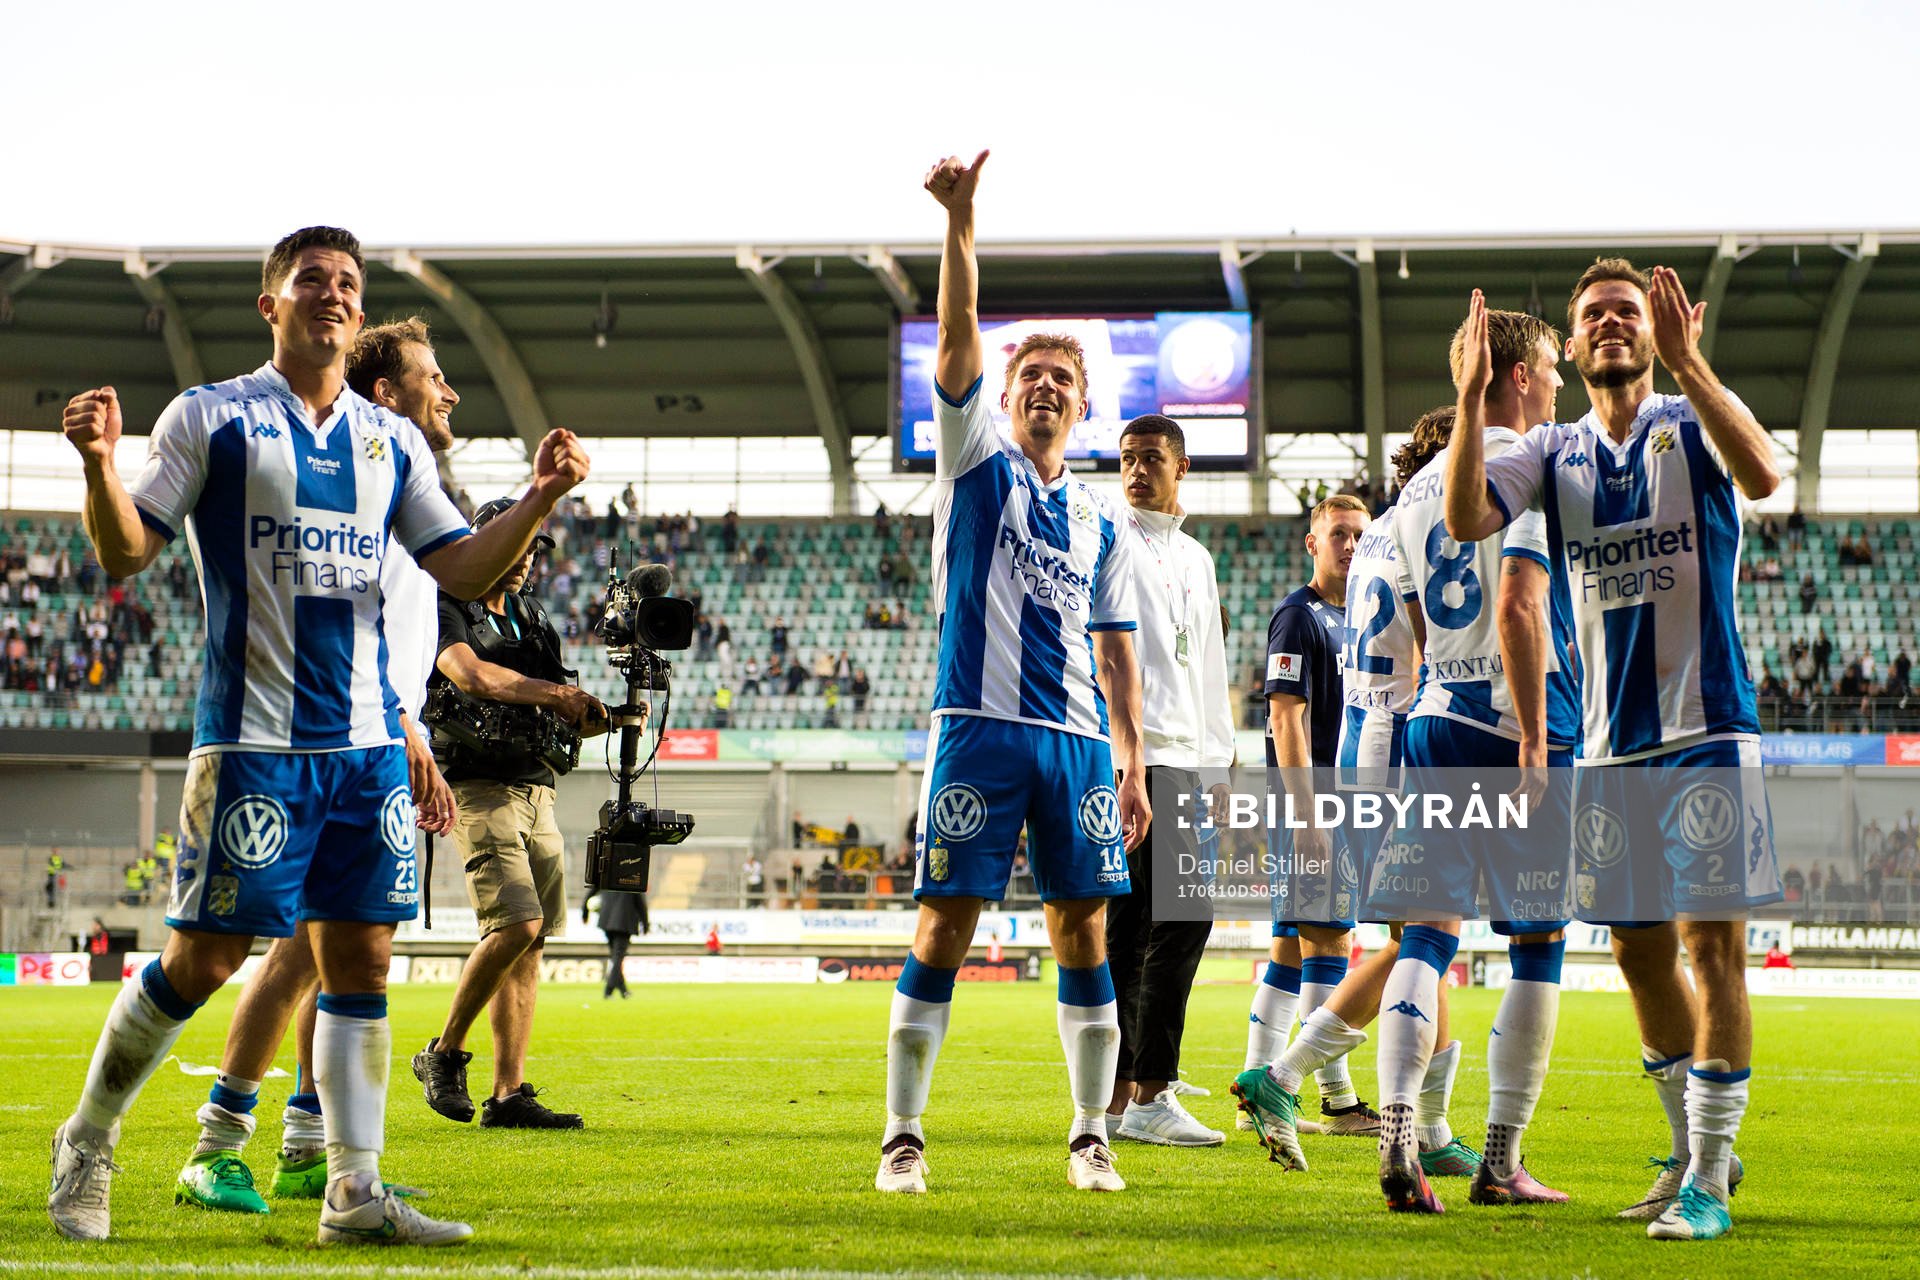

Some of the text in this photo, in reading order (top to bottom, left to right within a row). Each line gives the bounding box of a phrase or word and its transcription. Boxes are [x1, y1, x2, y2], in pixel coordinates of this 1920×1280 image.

[655, 395, 704, 413] P3
[1402, 472, 1444, 508] SER
[250, 515, 383, 561] Prioritet
[1566, 522, 1693, 573] Prioritet
[272, 551, 369, 593] Finans
[1000, 522, 1090, 592] Prioritet
[1425, 518, 1483, 630] 8
[1010, 555, 1080, 611] Finans
[1582, 566, 1675, 603] Finans
[1343, 574, 1396, 676] 42
[1807, 741, 1853, 760] PLATS
[394, 860, 416, 890] 23
[1099, 847, 1123, 872] 16
[1706, 854, 1724, 882] 2
[1516, 871, 1560, 892] NRC
[1688, 883, 1741, 896] Kappa
[1792, 926, 1920, 950] REKLAMFA
